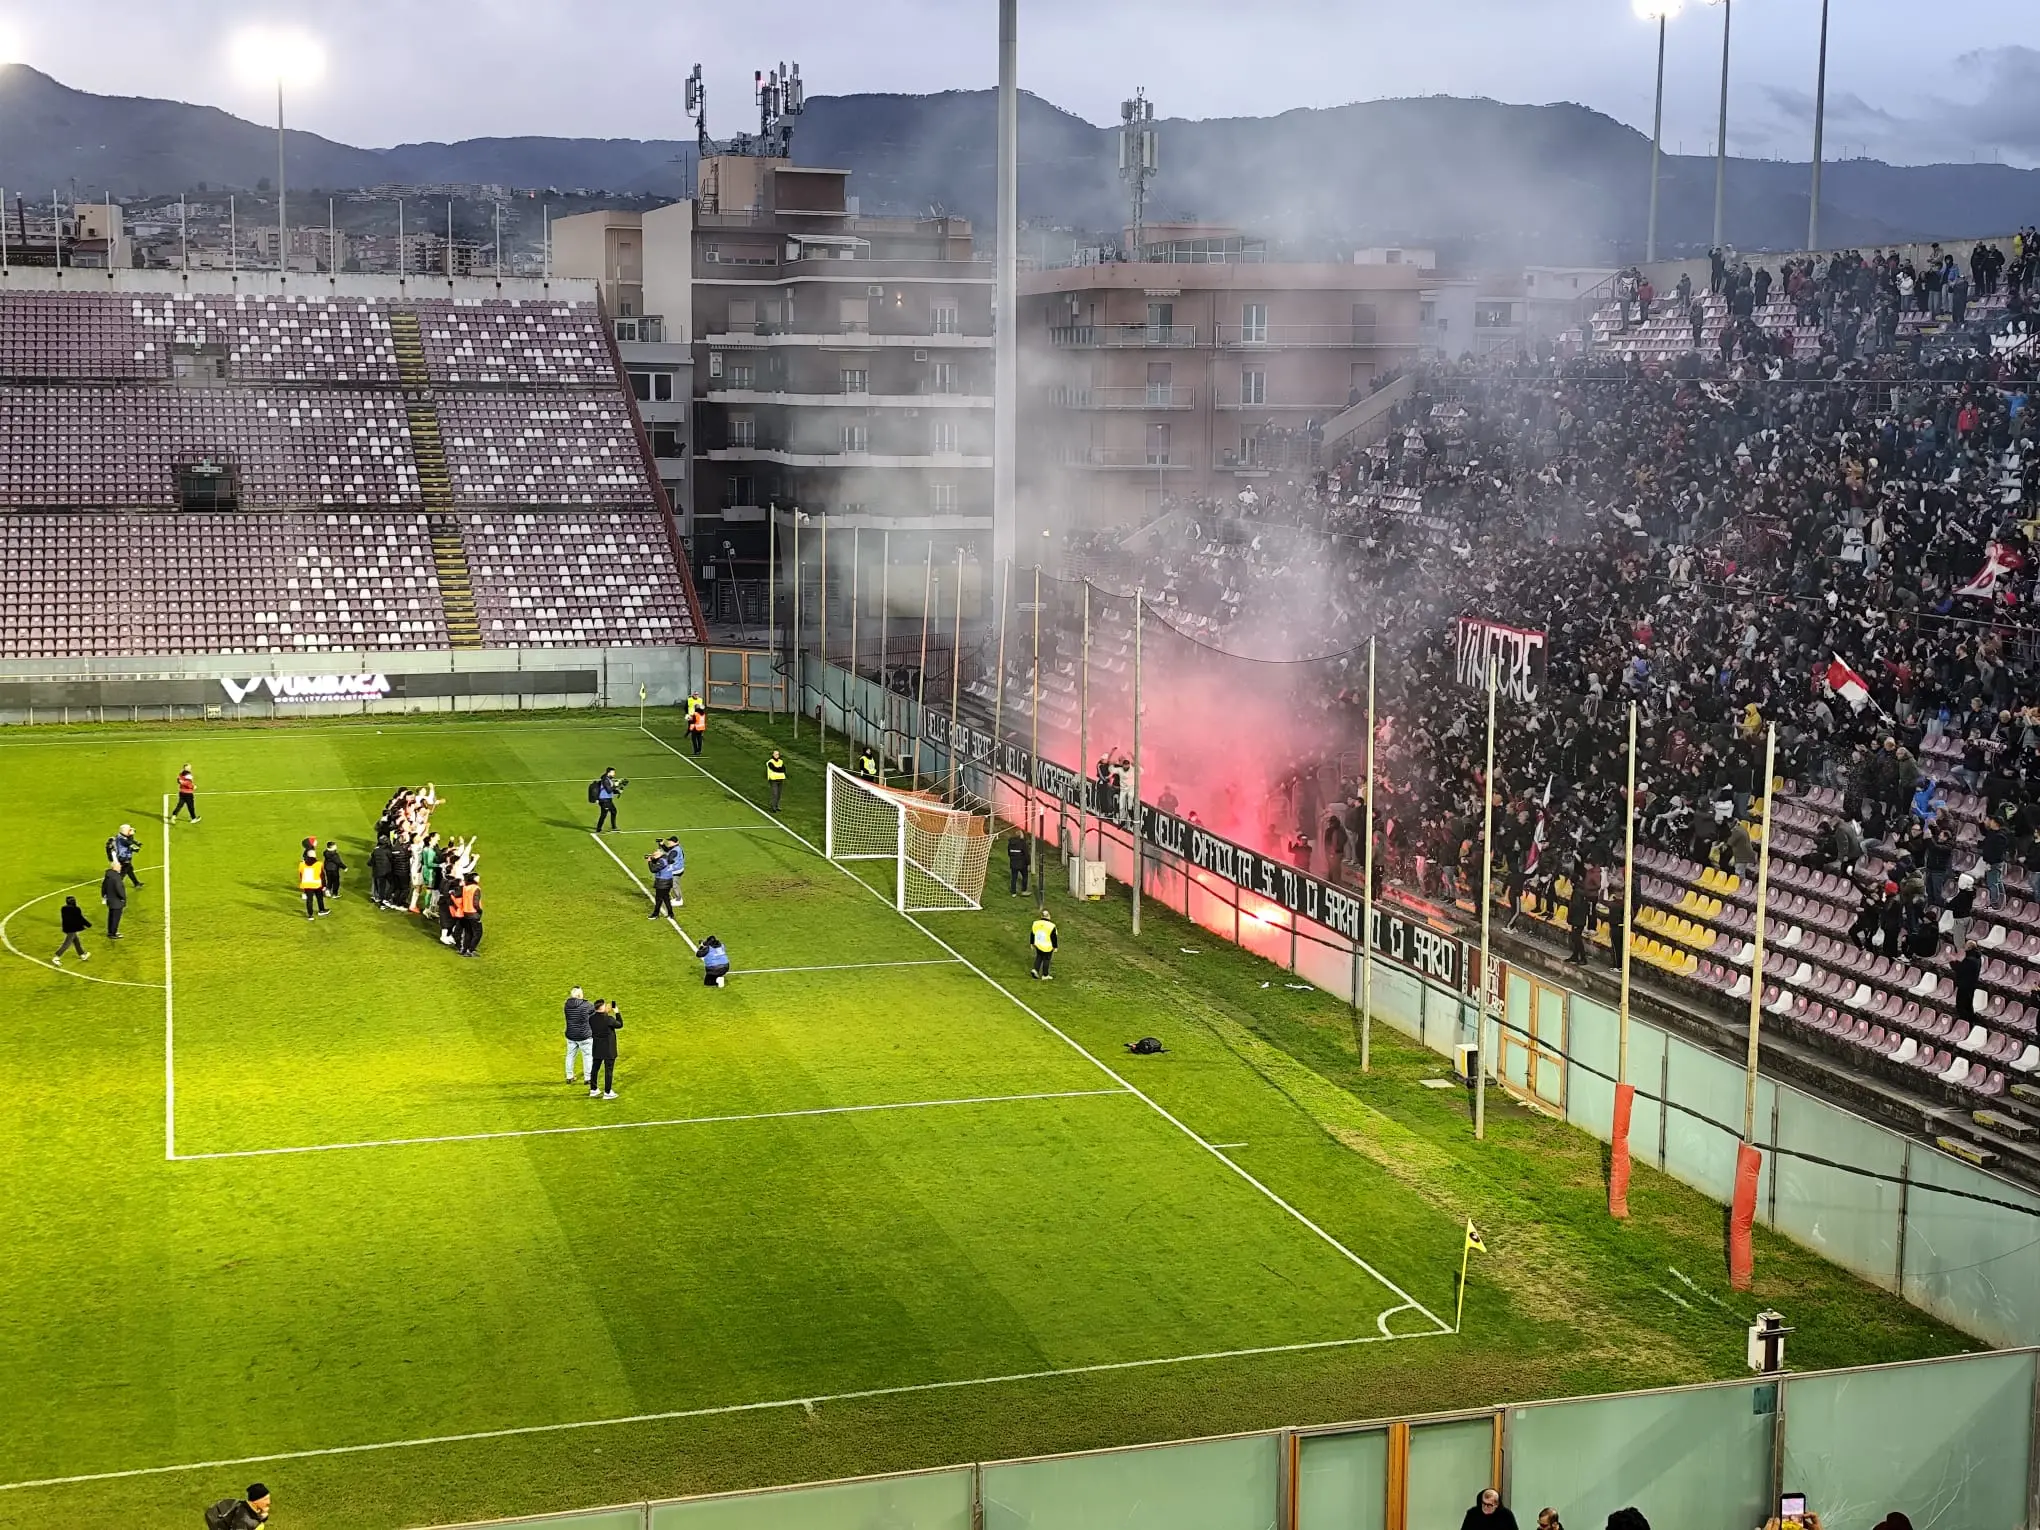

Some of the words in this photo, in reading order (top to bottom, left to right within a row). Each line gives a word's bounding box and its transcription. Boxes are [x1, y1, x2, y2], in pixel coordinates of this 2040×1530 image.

[1456, 620, 1543, 702] VINCERE
[1154, 812, 1186, 857] NELLE
[1281, 869, 1298, 911] TU
